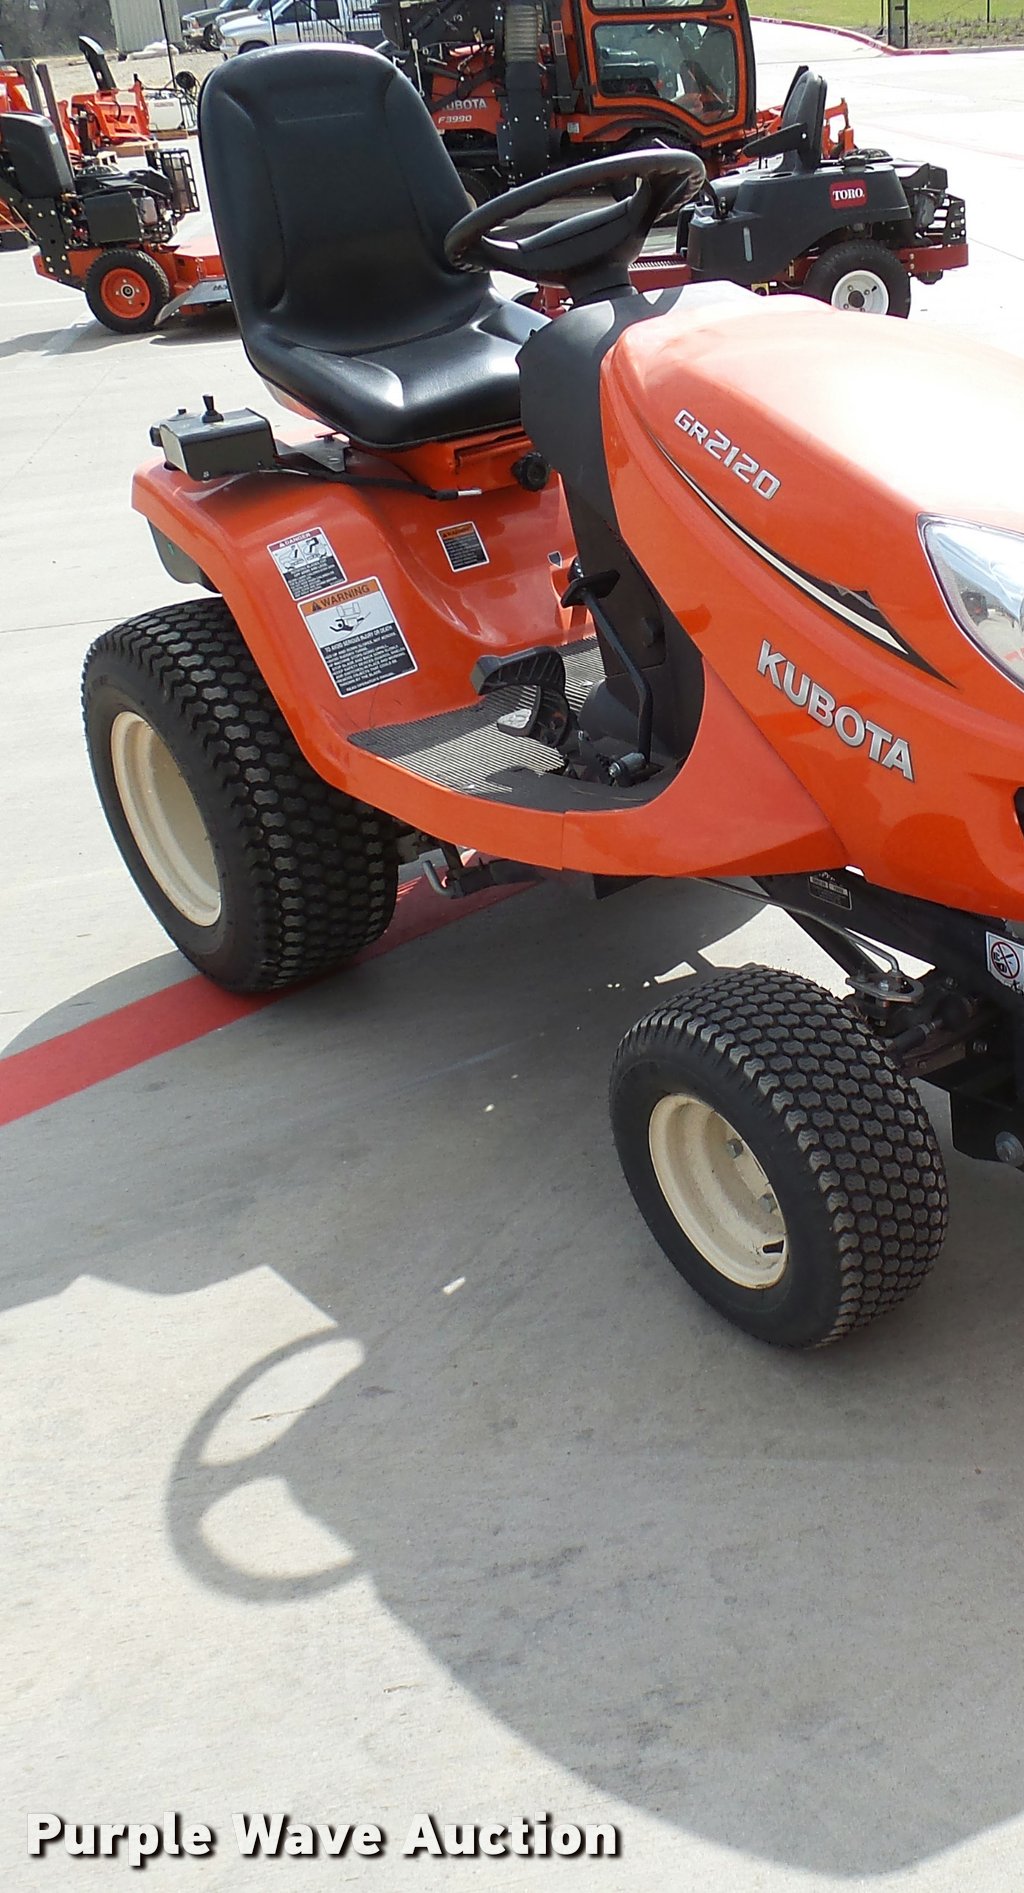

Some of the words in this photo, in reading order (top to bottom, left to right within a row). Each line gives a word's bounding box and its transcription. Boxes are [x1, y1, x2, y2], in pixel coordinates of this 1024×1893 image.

[441, 97, 487, 111] UBOTA
[438, 114, 473, 124] F3990
[832, 187, 863, 201] TORO
[673, 408, 782, 500] GR2120
[319, 584, 370, 607] WARNING
[757, 639, 915, 783] KUBOTA
